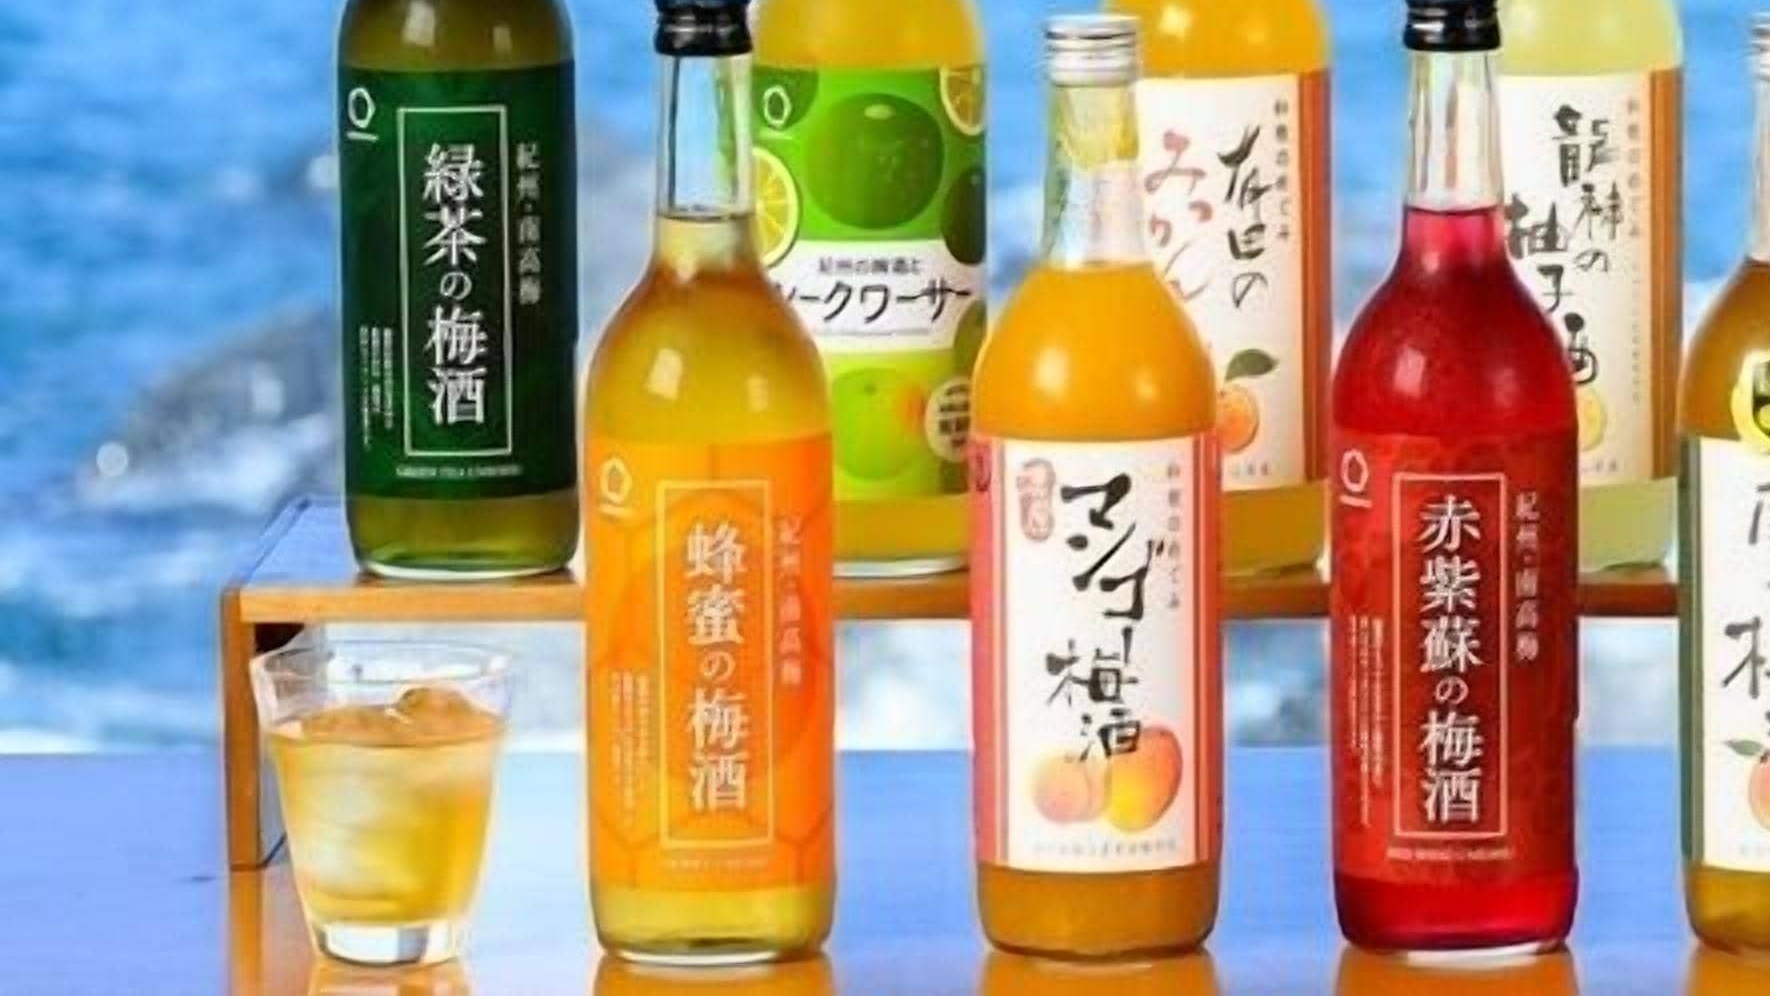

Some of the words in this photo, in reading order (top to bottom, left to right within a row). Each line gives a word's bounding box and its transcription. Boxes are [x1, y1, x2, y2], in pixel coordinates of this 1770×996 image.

[422, 142, 488, 425] 緑茶の梅酒
[775, 278, 971, 324] ークワーサー
[684, 521, 750, 811] 蜂蜜の梅酒
[1418, 494, 1484, 824] 赤紫蘇の梅酒
